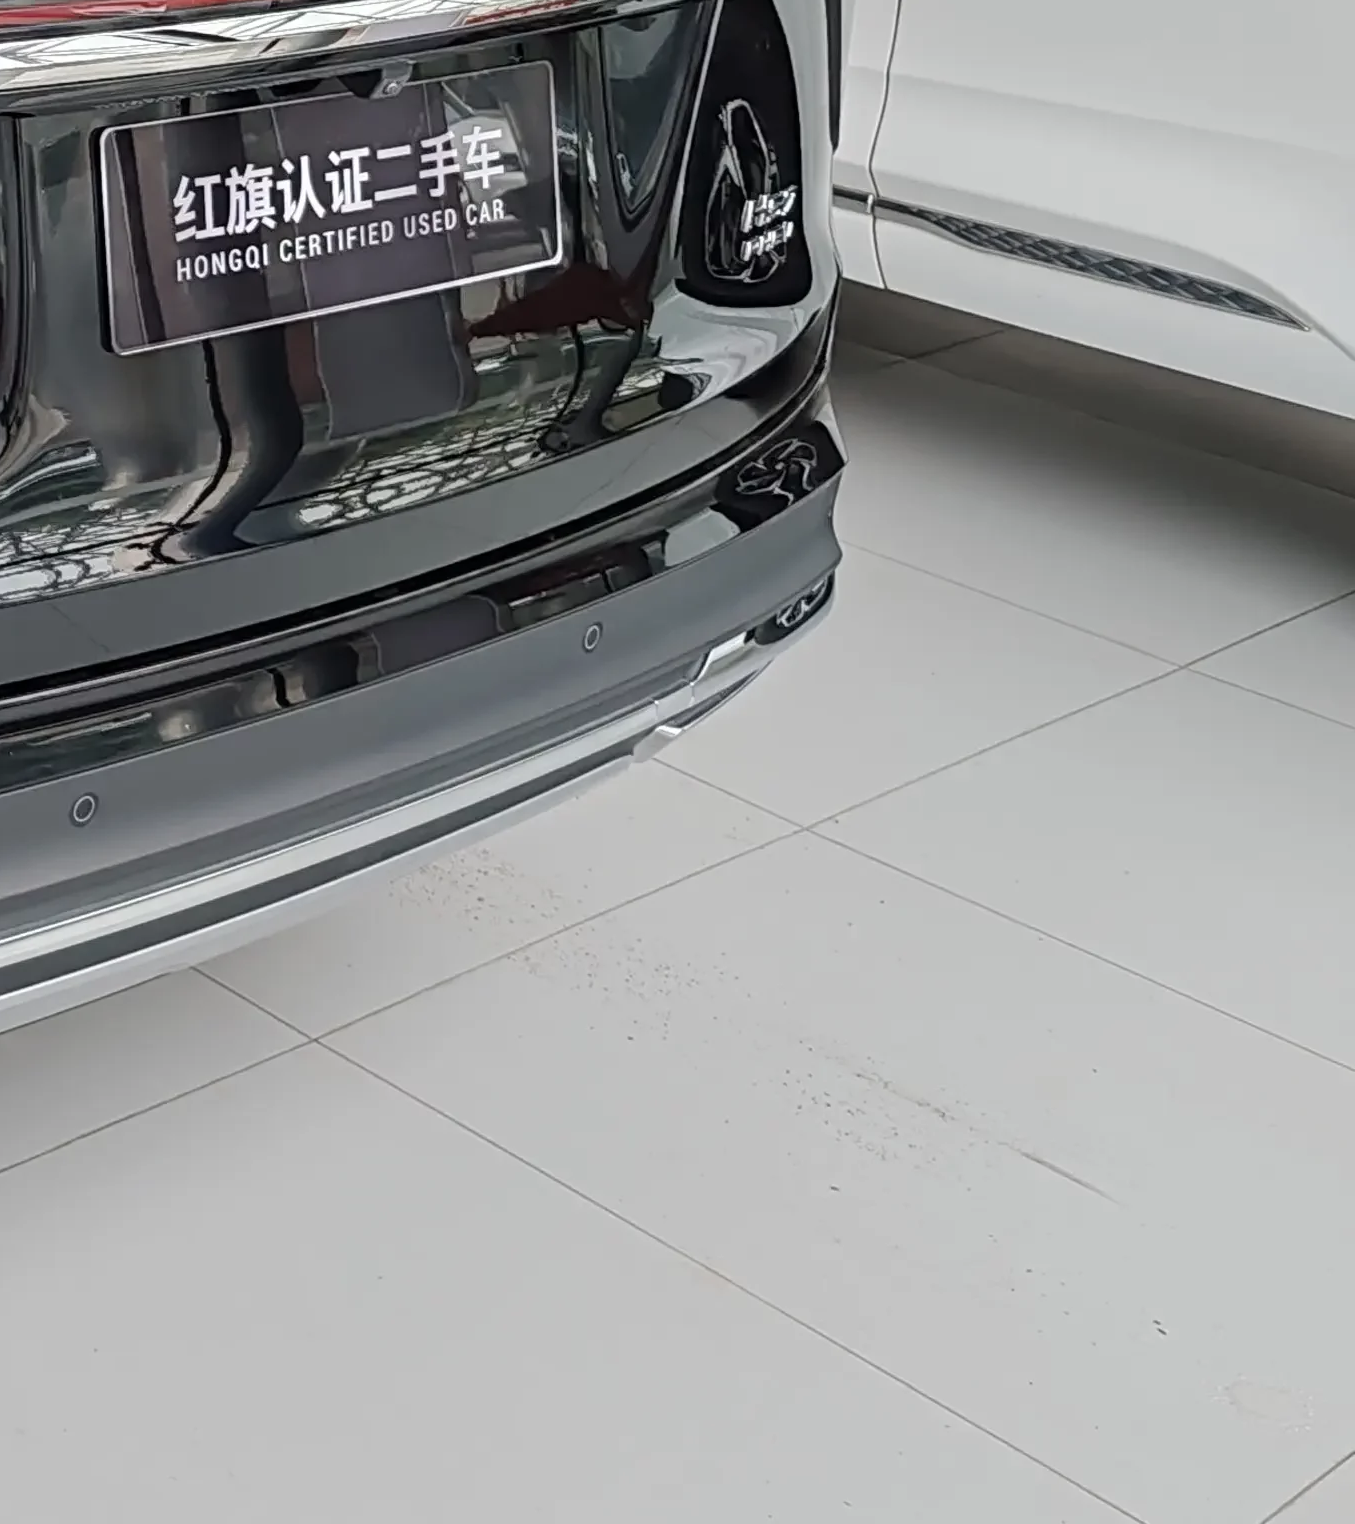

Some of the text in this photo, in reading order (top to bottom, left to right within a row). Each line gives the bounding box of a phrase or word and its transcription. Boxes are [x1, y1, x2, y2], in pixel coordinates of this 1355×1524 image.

[173, 124, 505, 243] 红旗认证二手车
[176, 199, 505, 282] HONGQI CERTIFIED USED CAR
